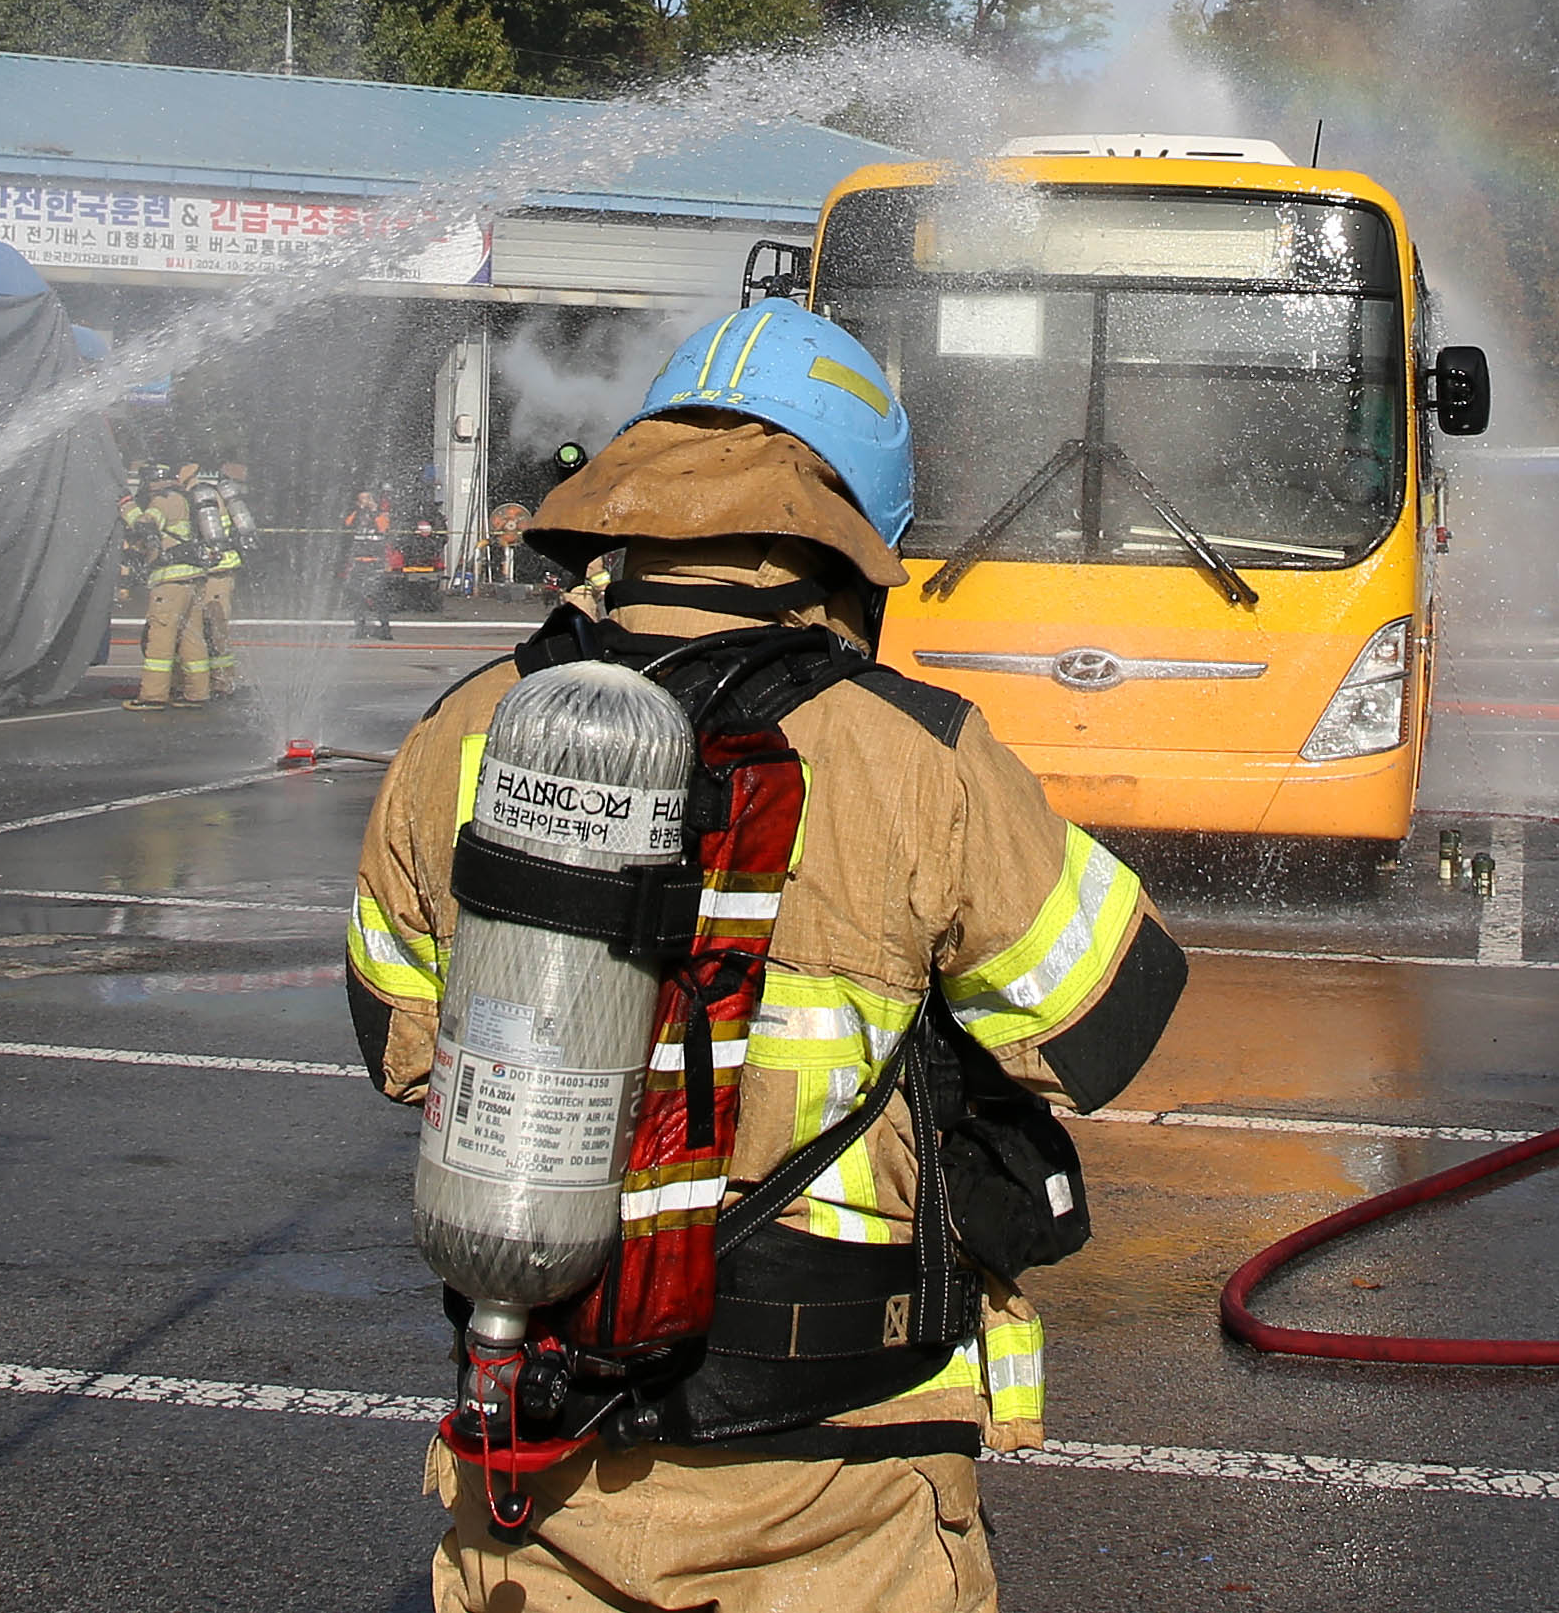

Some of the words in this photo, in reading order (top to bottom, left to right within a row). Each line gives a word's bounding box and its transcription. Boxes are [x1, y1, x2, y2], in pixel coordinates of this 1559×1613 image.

[181, 203, 199, 227] &
[27, 225, 97, 249] 전기버스
[107, 231, 174, 252] 대형화재
[185, 235, 200, 252] 및
[496, 768, 631, 820] HANCOM
[492, 798, 609, 844] 한컴라이프케어
[554, 1076, 610, 1089] 14003-4350
[496, 1090, 516, 1103] 2024
